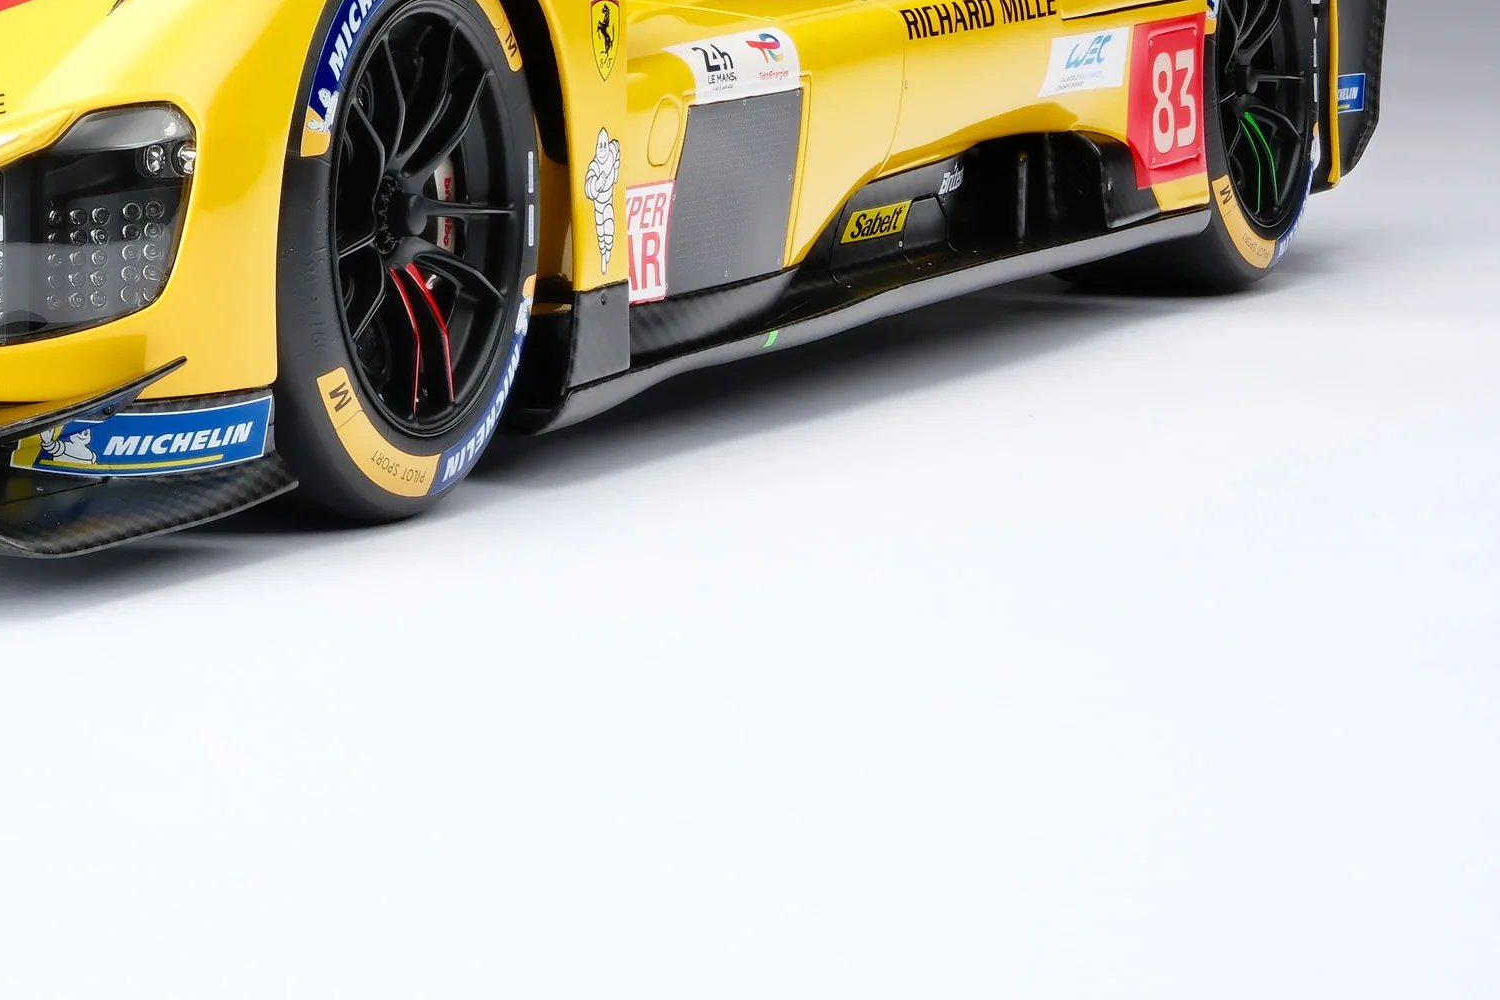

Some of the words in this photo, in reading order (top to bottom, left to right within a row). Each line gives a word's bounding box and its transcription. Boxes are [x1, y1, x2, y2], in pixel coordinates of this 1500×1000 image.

[505, 31, 518, 58] M
[1064, 34, 1112, 70] WEC
[1152, 48, 1197, 154] 83
[850, 205, 903, 238] Sabelt
[442, 343, 521, 483] MICHELIN
[102, 420, 254, 457] MICHELIN
[370, 449, 400, 477] SPORT
[401, 467, 427, 484] PILOT
